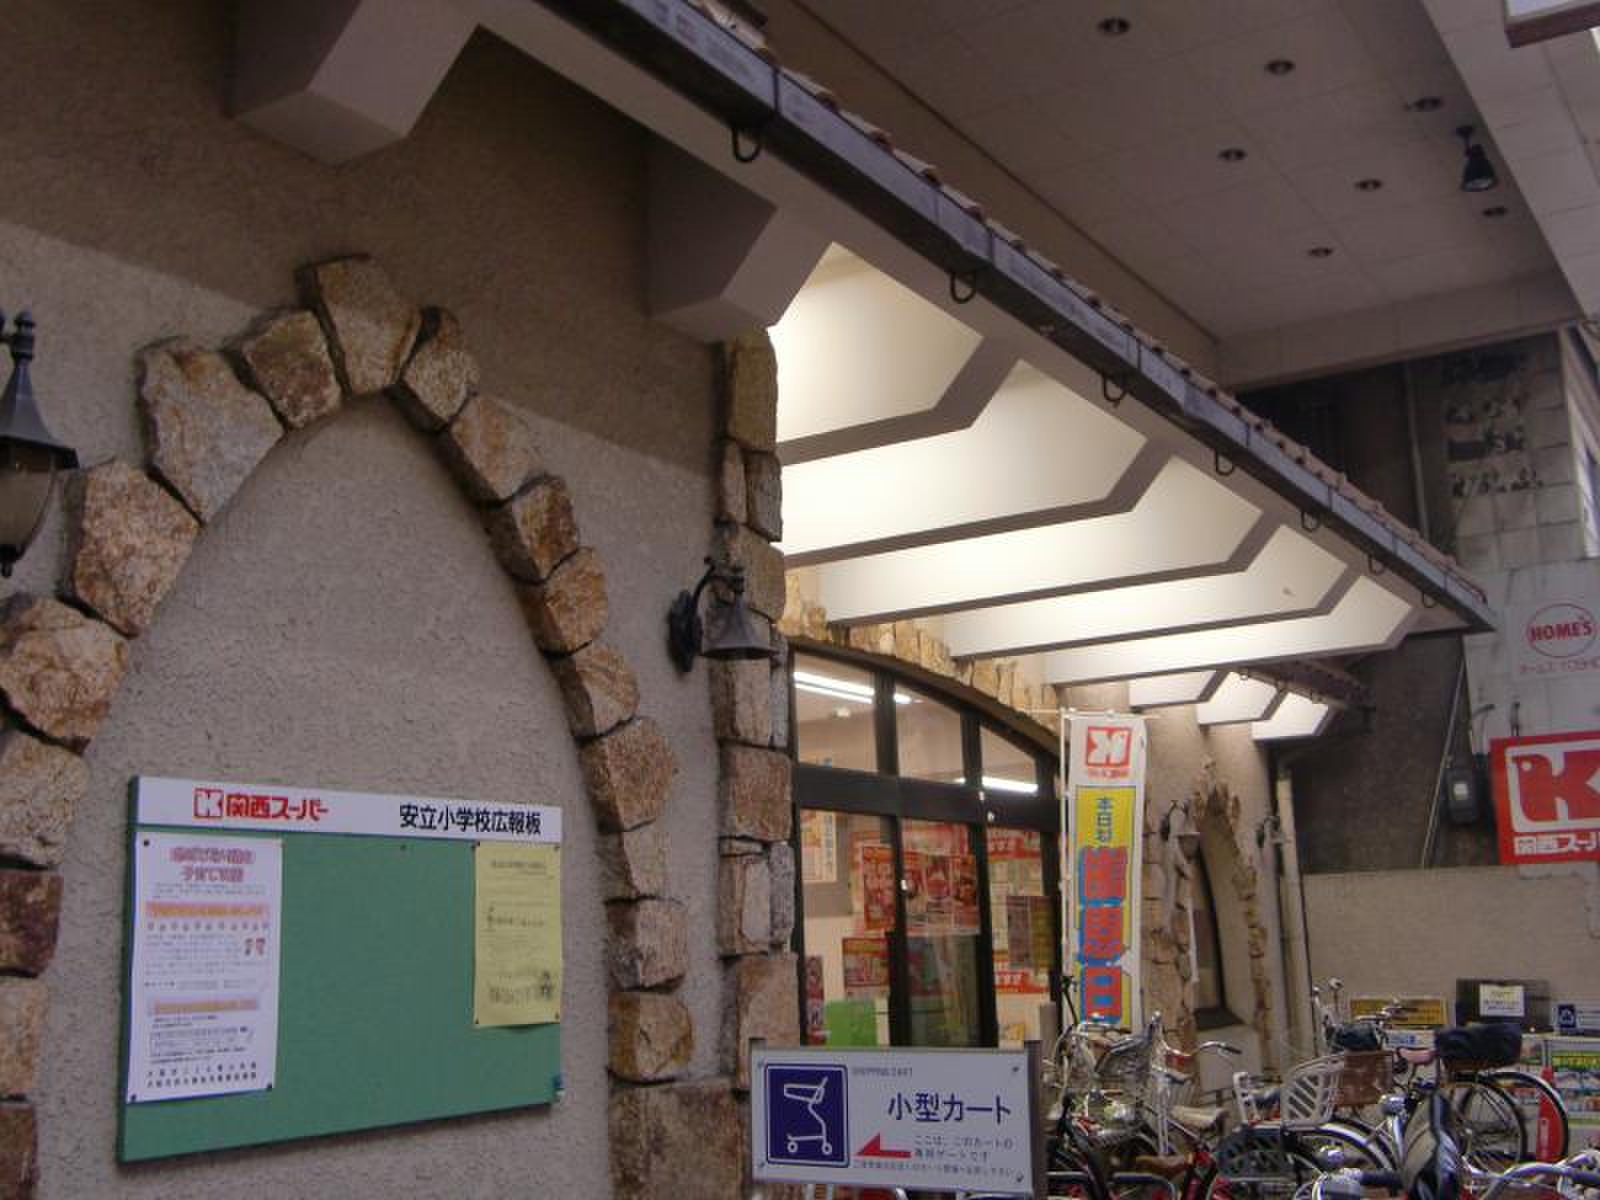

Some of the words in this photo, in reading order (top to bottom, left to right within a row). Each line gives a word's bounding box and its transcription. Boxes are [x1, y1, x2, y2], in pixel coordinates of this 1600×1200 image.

[399, 803, 542, 835] 安立小学校広報板
[886, 1091, 1011, 1124] 小型カート
